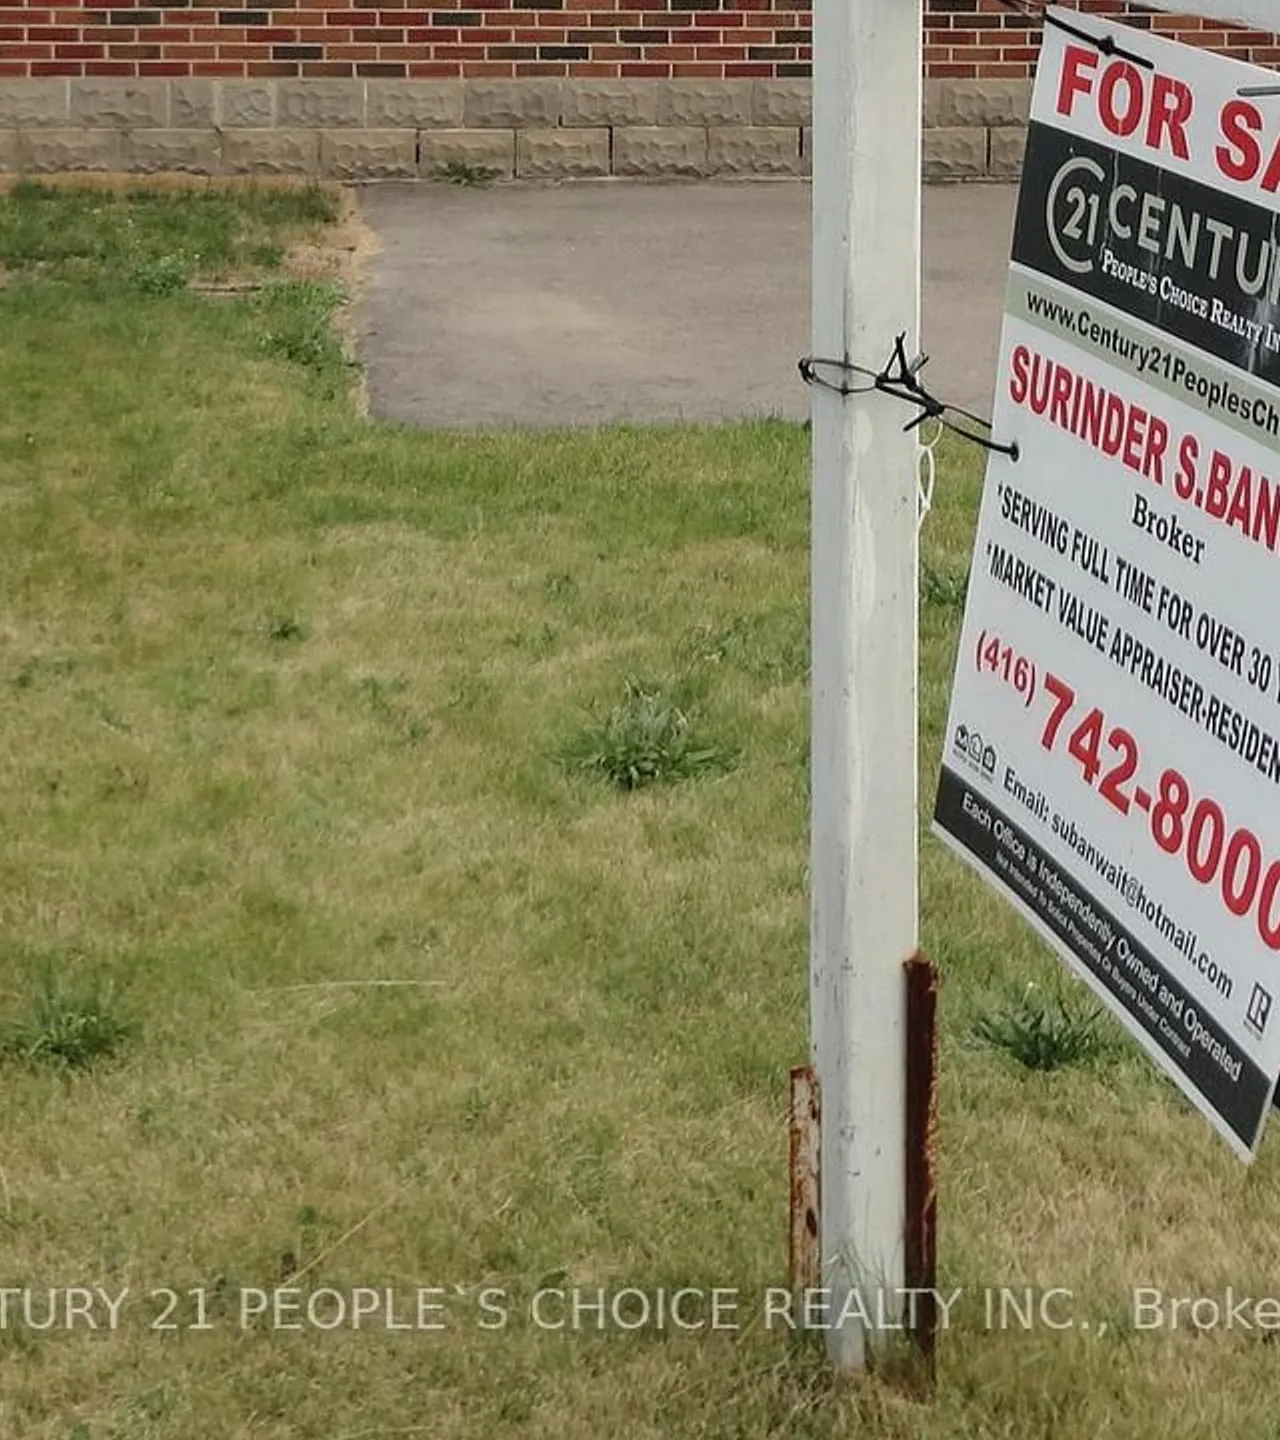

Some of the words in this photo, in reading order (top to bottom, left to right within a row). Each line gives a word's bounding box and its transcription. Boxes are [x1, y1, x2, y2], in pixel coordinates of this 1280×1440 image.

[1056, 45, 1193, 160] FOR
[1010, 345, 1168, 485] SURINDER
[1132, 494, 1205, 564] Broker
[976, 630, 1035, 707] (416)
[1059, 587, 1109, 653] VALUE
[1071, 529, 1109, 584] FULL
[1116, 556, 1155, 613] TIME
[1157, 586, 1193, 640] FOR
[1196, 612, 1245, 676] OVER
[1248, 647, 1271, 692] 30
[962, 791, 991, 832] Each
[993, 819, 1026, 861] Office
[1038, 859, 1116, 951] Independently
[1117, 937, 1159, 990] Owned
[1159, 985, 1185, 1018] and
[1184, 1008, 1243, 1082] Operated
[1004, 767, 1049, 822] Email:
[1051, 813, 1233, 999] subanwait@hotmail.com
